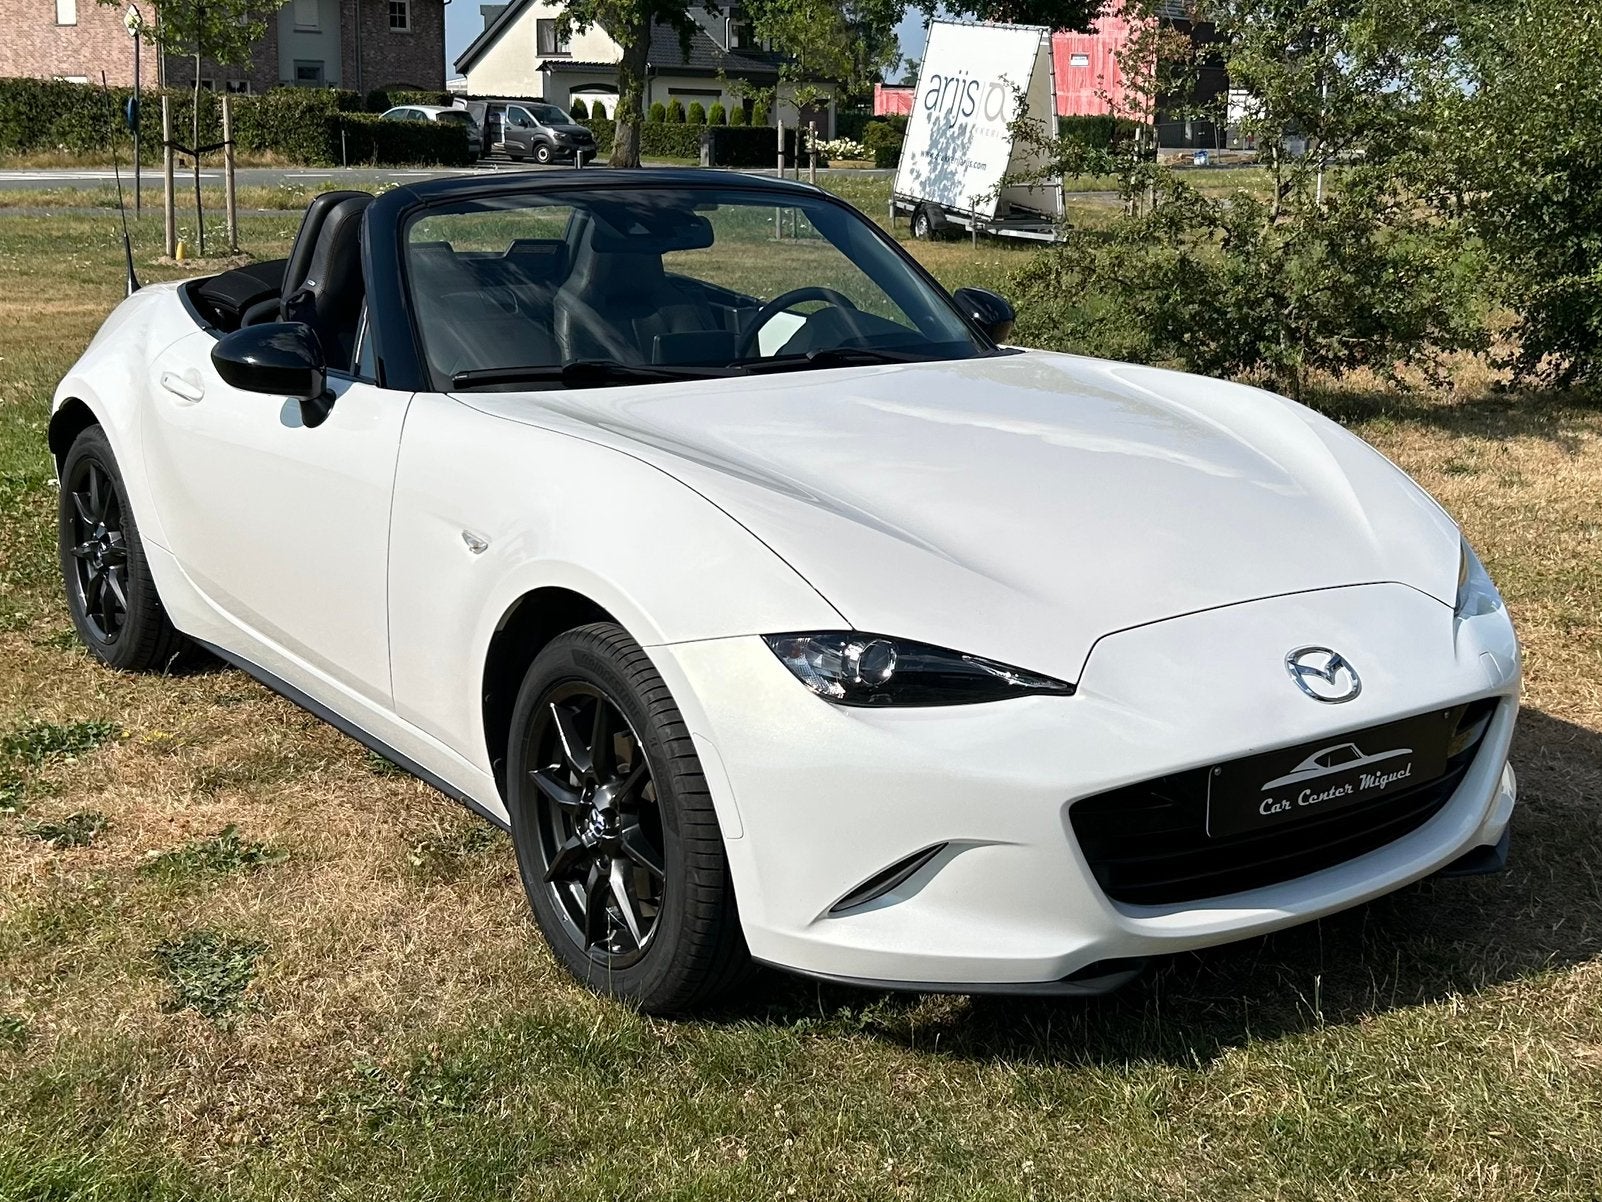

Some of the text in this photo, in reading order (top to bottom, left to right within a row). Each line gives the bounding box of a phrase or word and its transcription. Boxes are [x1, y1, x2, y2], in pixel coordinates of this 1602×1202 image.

[924, 69, 979, 129] arijs
[1258, 762, 1412, 815] Car Center Miguel
